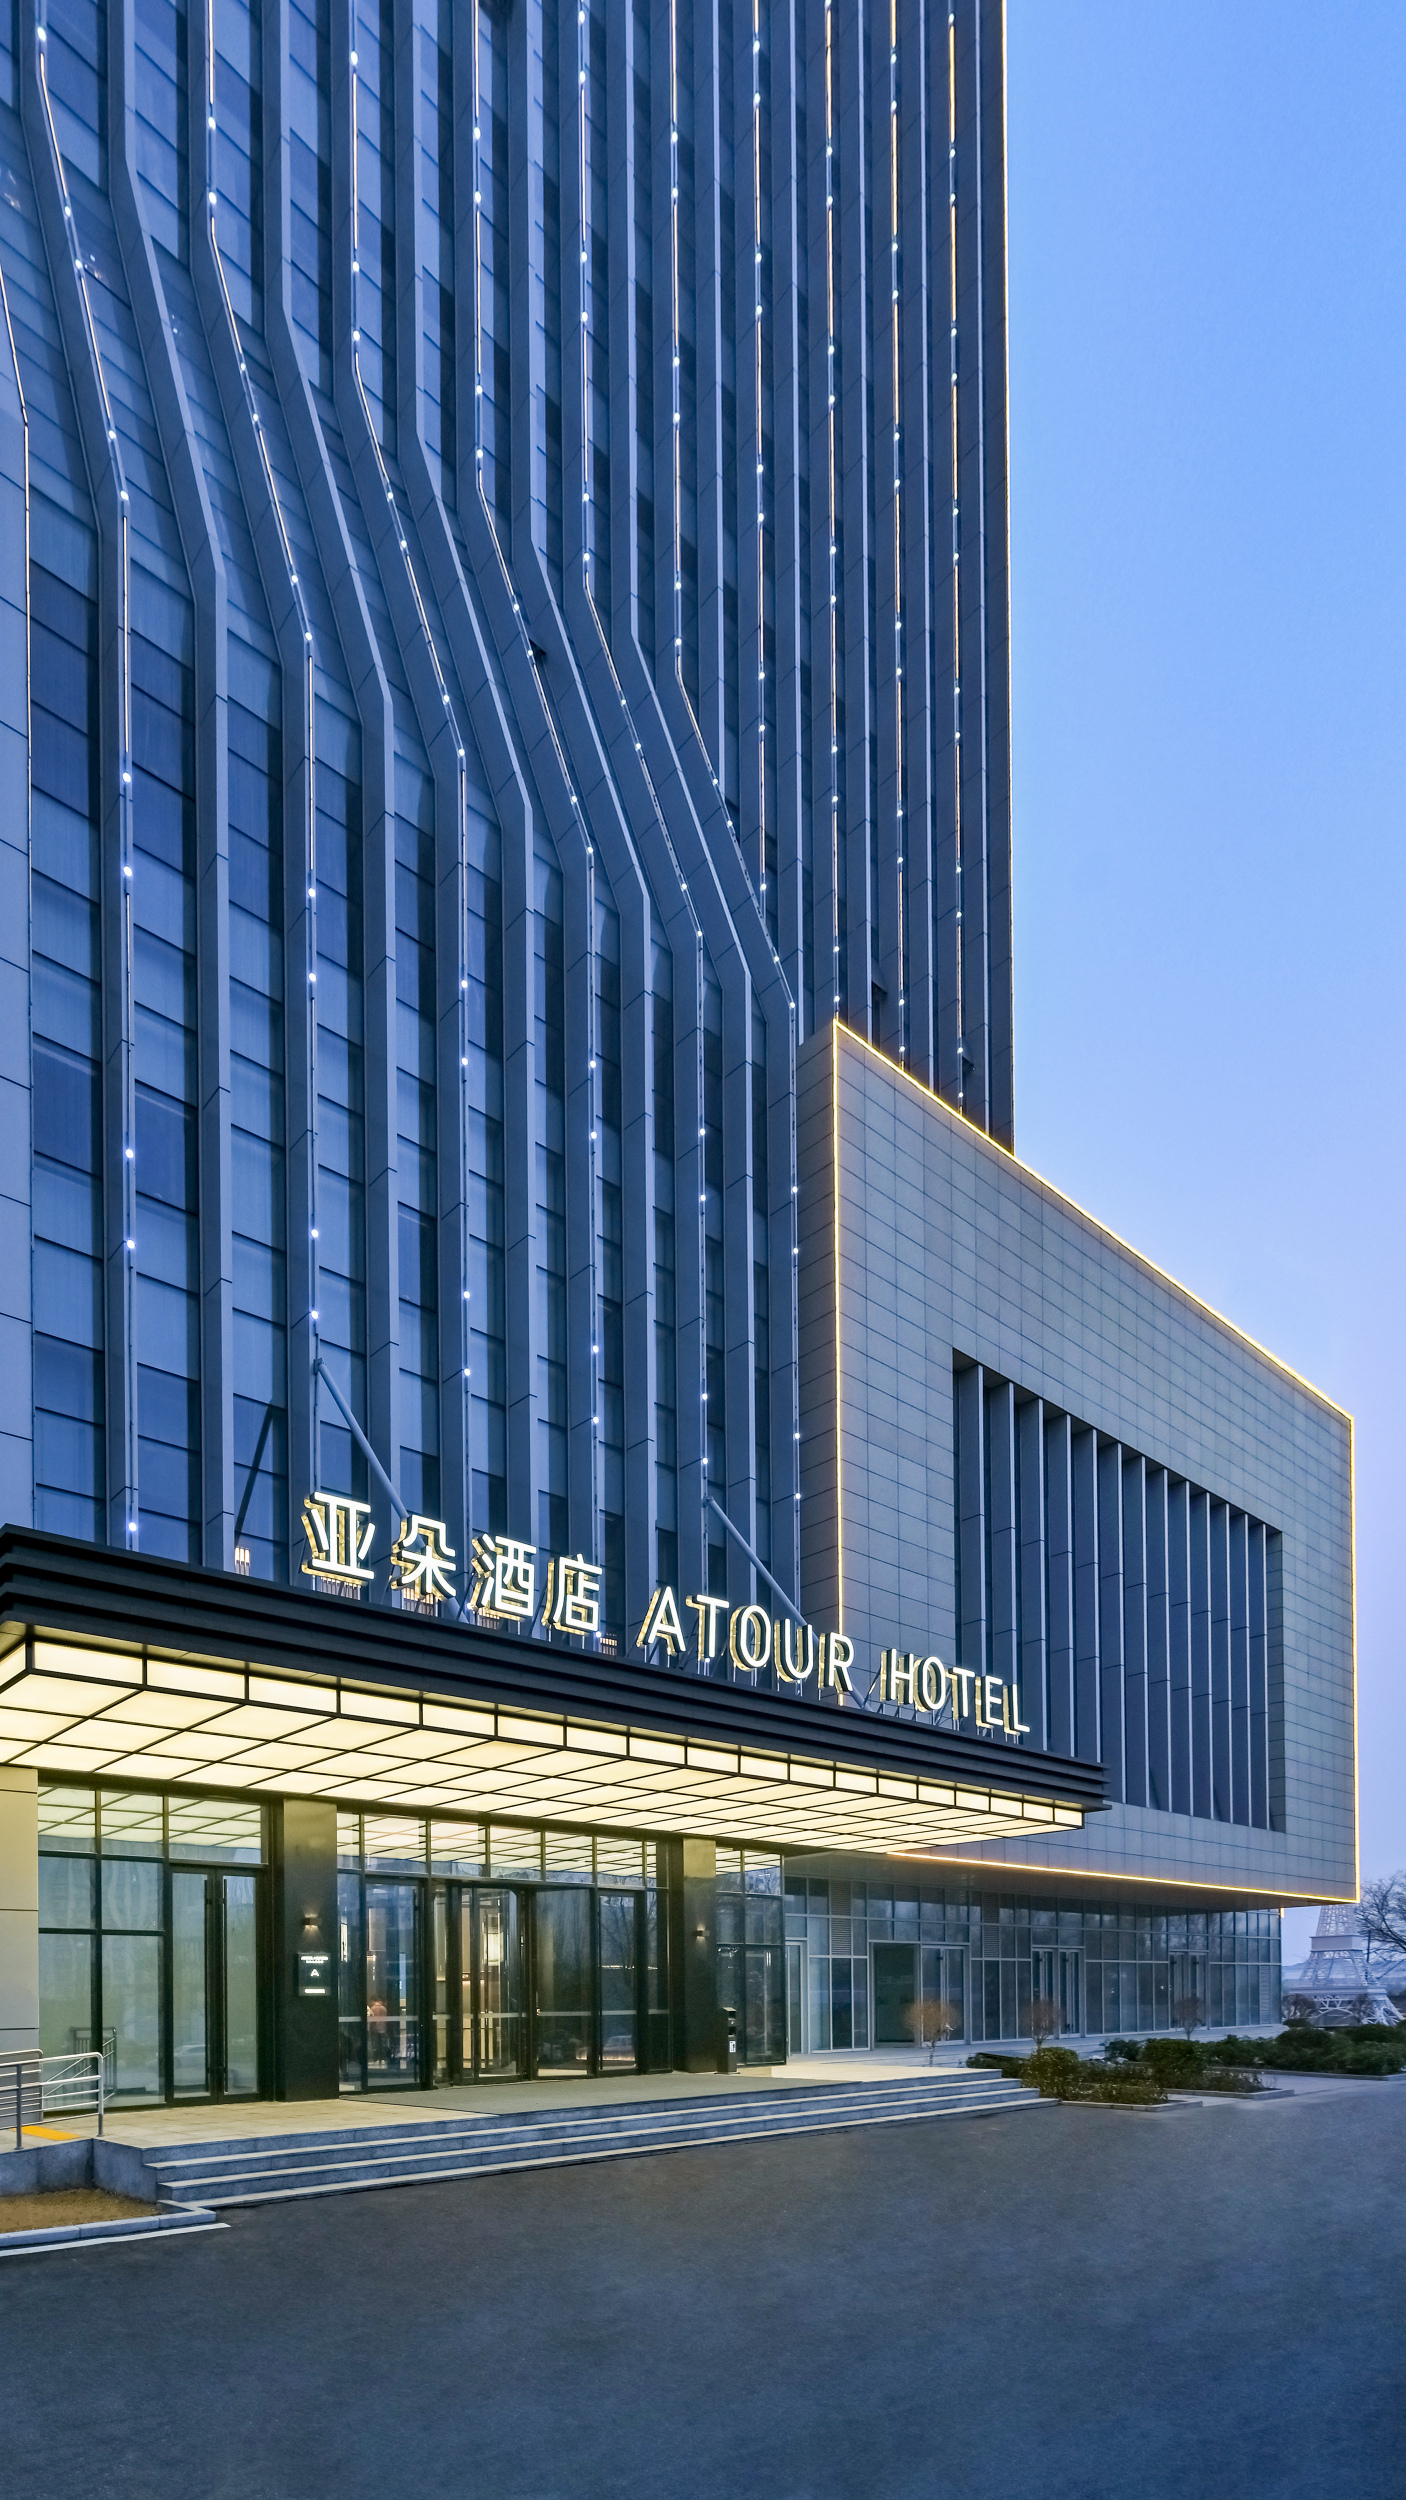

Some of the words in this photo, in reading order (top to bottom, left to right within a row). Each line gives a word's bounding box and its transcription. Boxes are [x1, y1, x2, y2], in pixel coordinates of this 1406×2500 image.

[302, 1491, 603, 1635] 亚朵酒店
[637, 1586, 855, 1693] ATOUR
[880, 1648, 1031, 1734] HOTEL
